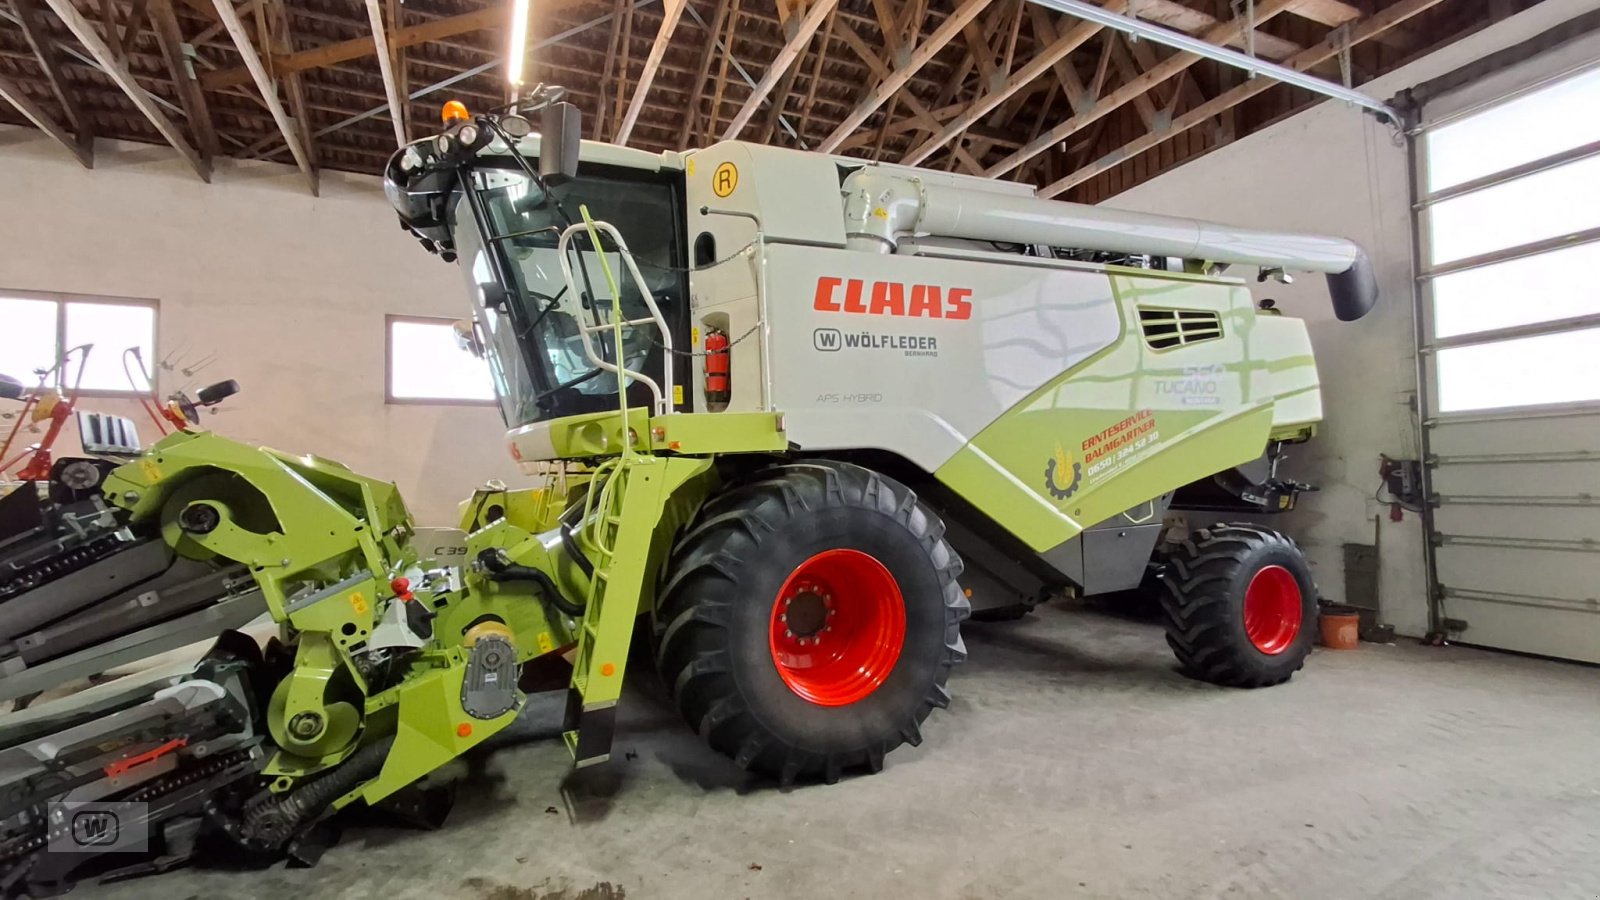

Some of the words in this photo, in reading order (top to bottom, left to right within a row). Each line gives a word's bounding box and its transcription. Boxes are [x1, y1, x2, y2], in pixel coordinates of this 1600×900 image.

[719, 169, 731, 191] R
[813, 276, 973, 320] CLAAS
[844, 331, 937, 350] WÖLFLEDER
[816, 393, 840, 403] APS
[843, 393, 883, 403] HYBRID
[1153, 379, 1217, 395] TUCANO
[1081, 407, 1153, 452] ERNTESERVICE
[1085, 418, 1156, 464] BAUMGARTNER
[1087, 456, 1112, 477] 0650
[1116, 444, 1134, 461] 324
[1135, 437, 1147, 450] 52
[1147, 430, 1160, 444] 30
[434, 546, 445, 555] C
